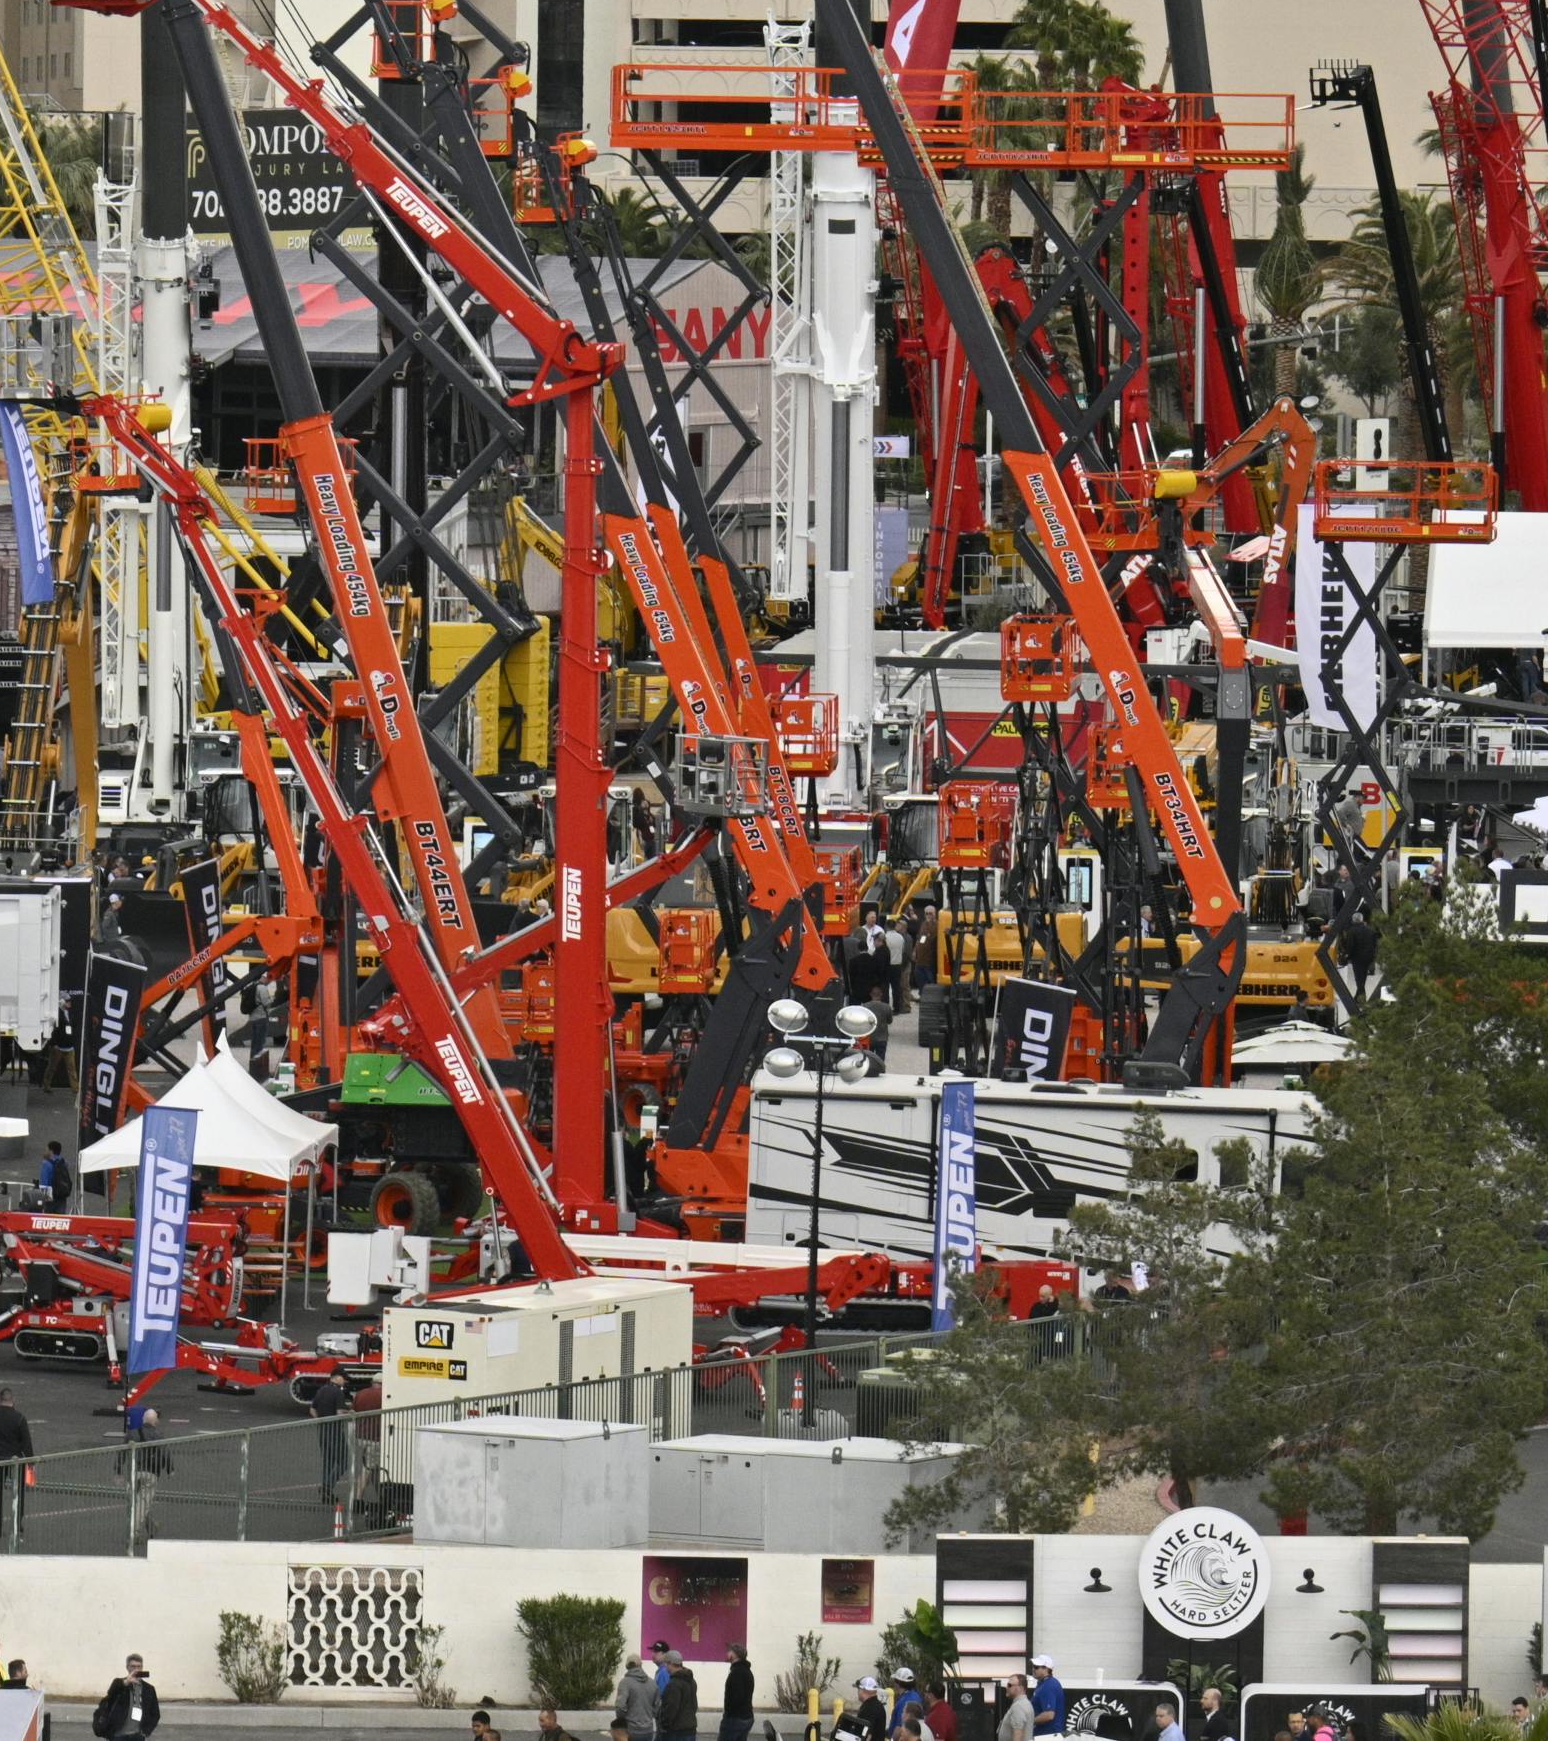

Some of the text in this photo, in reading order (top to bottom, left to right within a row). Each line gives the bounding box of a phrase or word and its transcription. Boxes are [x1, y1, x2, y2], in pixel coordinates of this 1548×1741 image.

[387, 177, 450, 238] TEUPEN
[651, 306, 773, 362] SANY
[314, 473, 370, 618] Heavy Loading 454kg
[1027, 473, 1083, 584] Heavy Loading 454kg
[1263, 523, 1288, 585] ATLAS
[619, 532, 675, 644] Heavy Loading 454kg
[379, 694, 402, 741] Dingli
[1119, 689, 1139, 727] Dingli
[767, 764, 801, 838] BT18CRT
[1154, 771, 1203, 860] BT34HRT
[414, 820, 463, 930] BT44ERT
[562, 866, 582, 943] TEUPEN
[998, 917, 1019, 925] 924
[1273, 954, 1300, 963] 924
[94, 984, 129, 1135] DINGLI
[435, 1033, 483, 1106] TEUPEN
[32, 1216, 71, 1232] TEUPEN
[135, 1154, 190, 1342] TEUPEN
[418, 1322, 451, 1347] CAT
[404, 1360, 466, 1377] EMPIRE CAT
[1153, 1522, 1252, 1590] WHITE CLAW
[1170, 1569, 1253, 1622] HARD SELTZER
[684, 1615, 700, 1643] 1
[1092, 1693, 1129, 1717] CLAW
